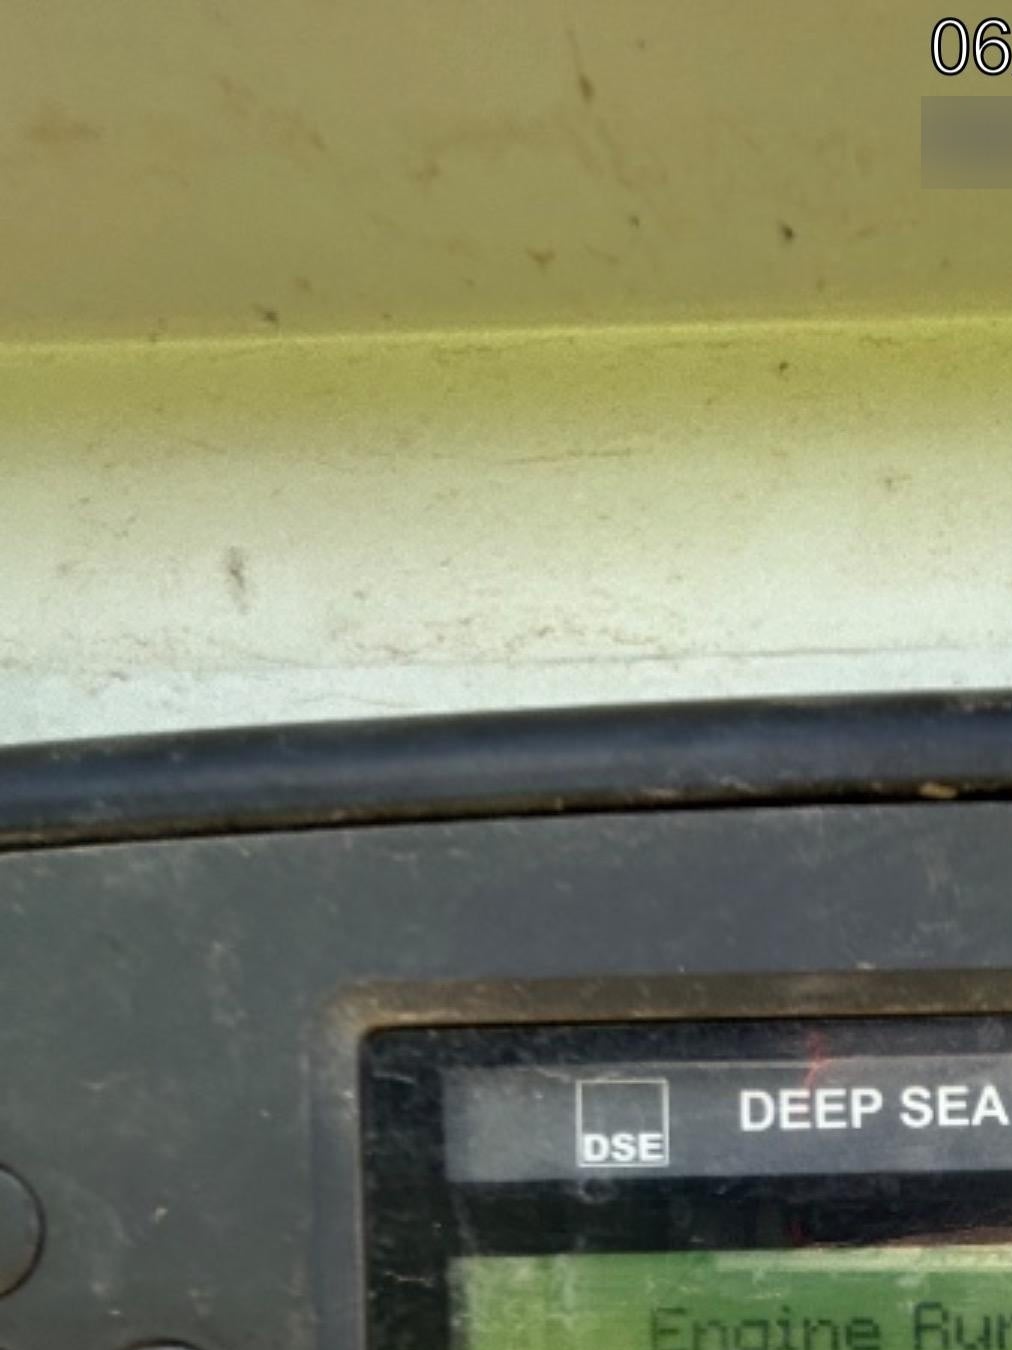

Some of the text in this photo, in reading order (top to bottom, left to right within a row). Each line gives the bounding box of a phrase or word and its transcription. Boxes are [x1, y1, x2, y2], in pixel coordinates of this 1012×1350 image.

[738, 1086, 884, 1133] DEEP
[899, 1083, 1009, 1128] SEA
[581, 1131, 664, 1163] DSE
